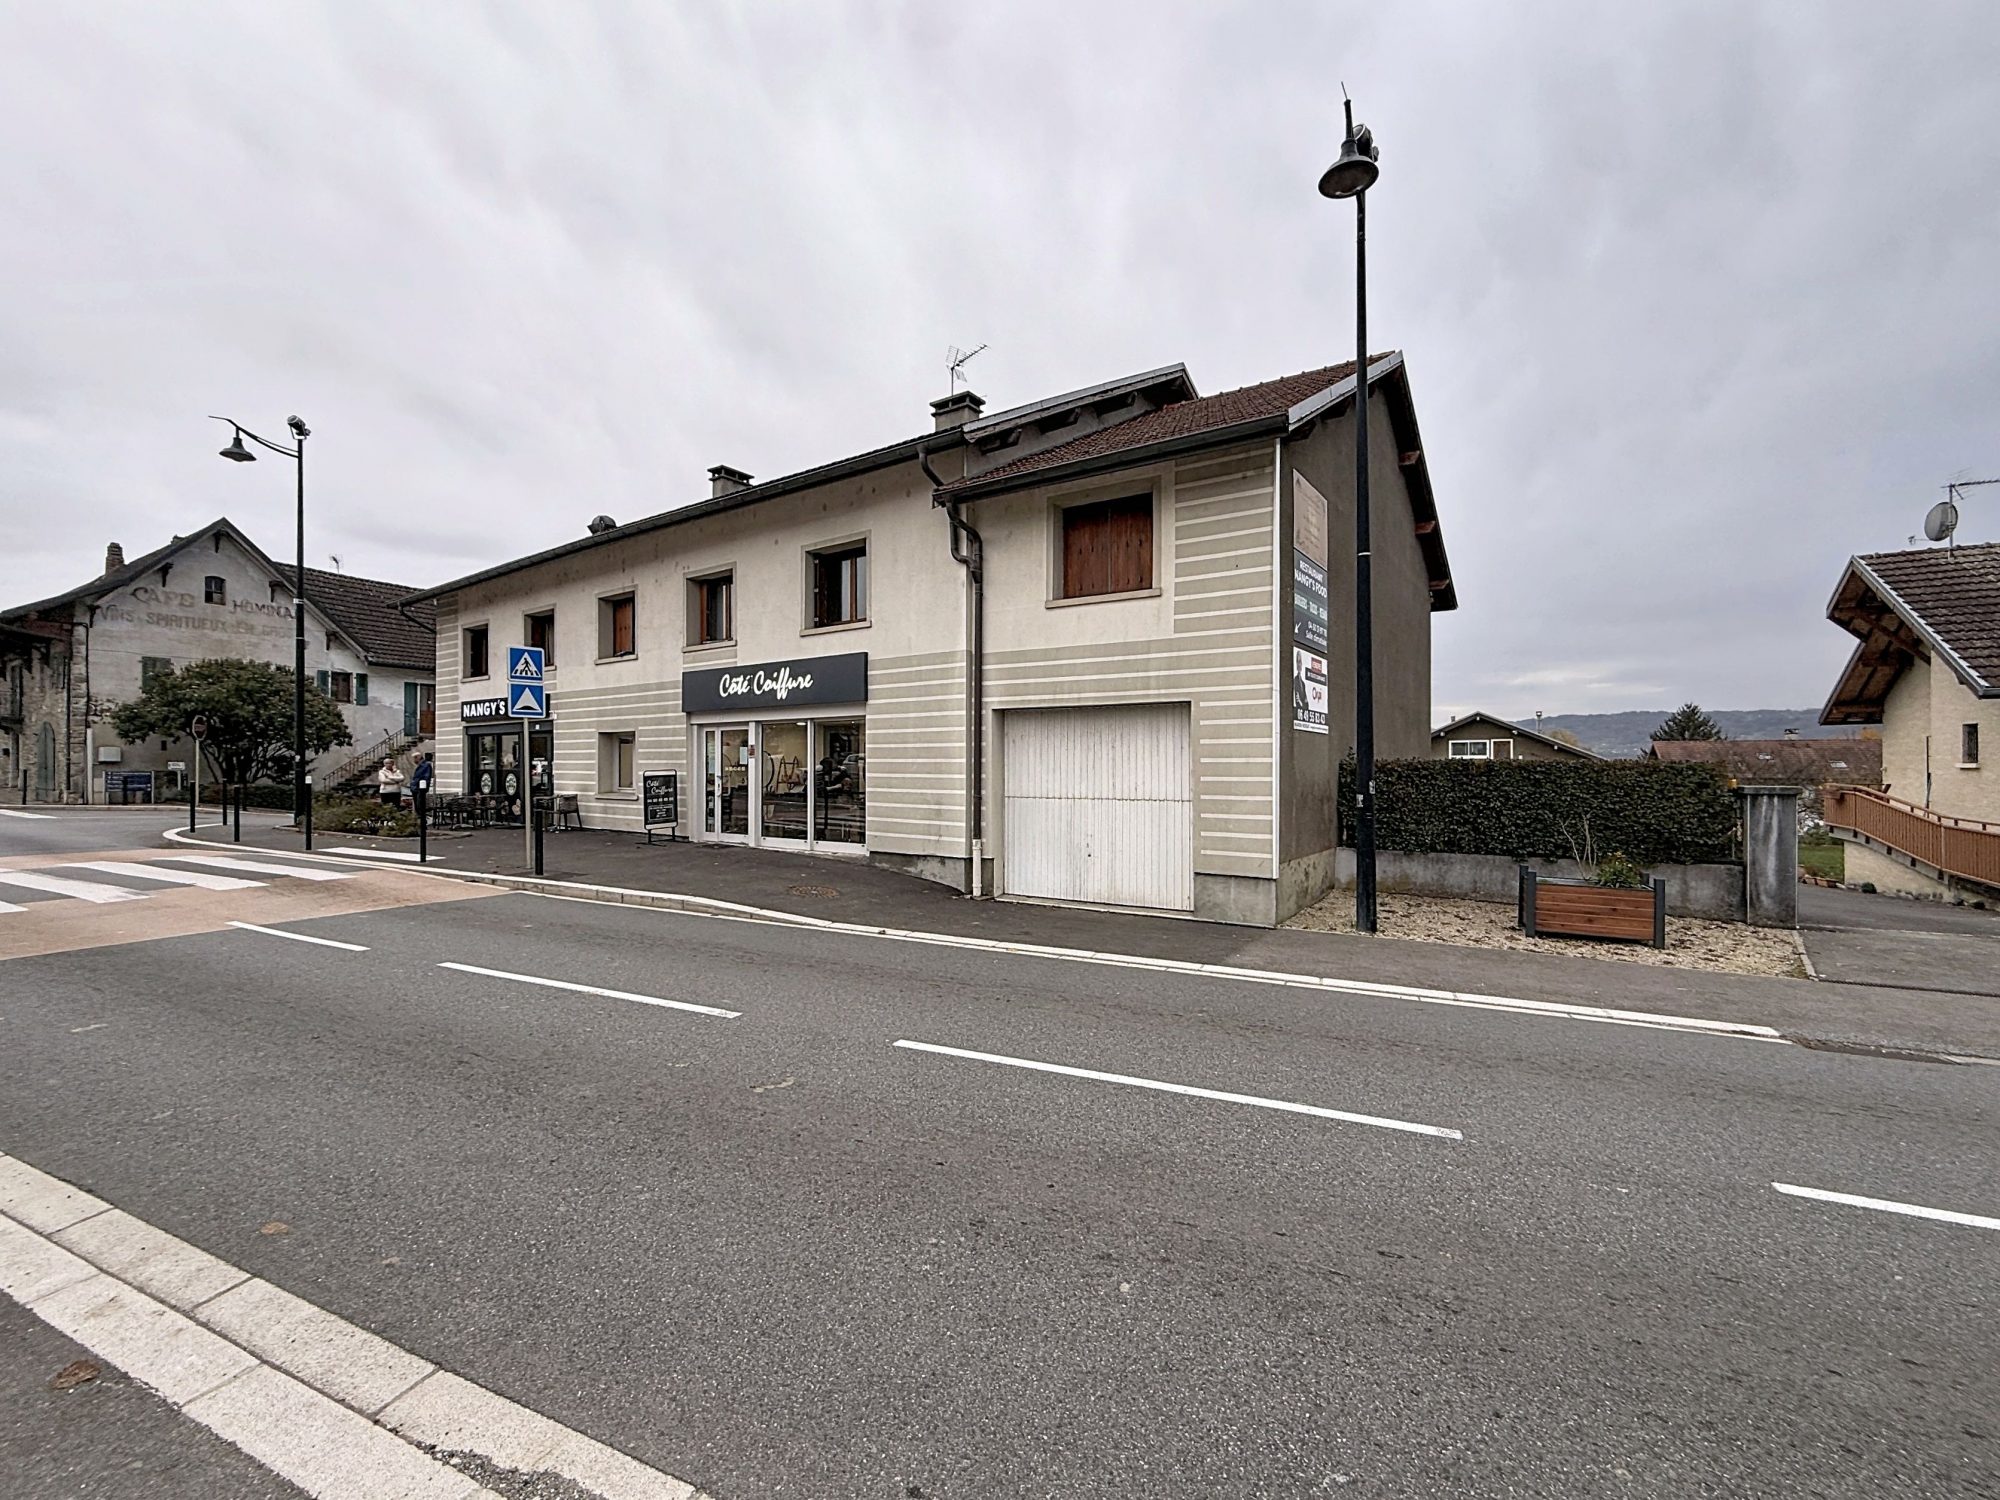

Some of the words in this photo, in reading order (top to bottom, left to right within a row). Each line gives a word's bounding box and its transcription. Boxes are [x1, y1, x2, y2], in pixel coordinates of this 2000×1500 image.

[1294, 568, 1316, 591] NANGY'S
[1315, 581, 1328, 598] FOOD
[719, 672, 751, 698] Côté
[752, 666, 814, 700] Coiffure
[1312, 686, 1322, 703] Orpi
[462, 699, 506, 718] NANGY'S
